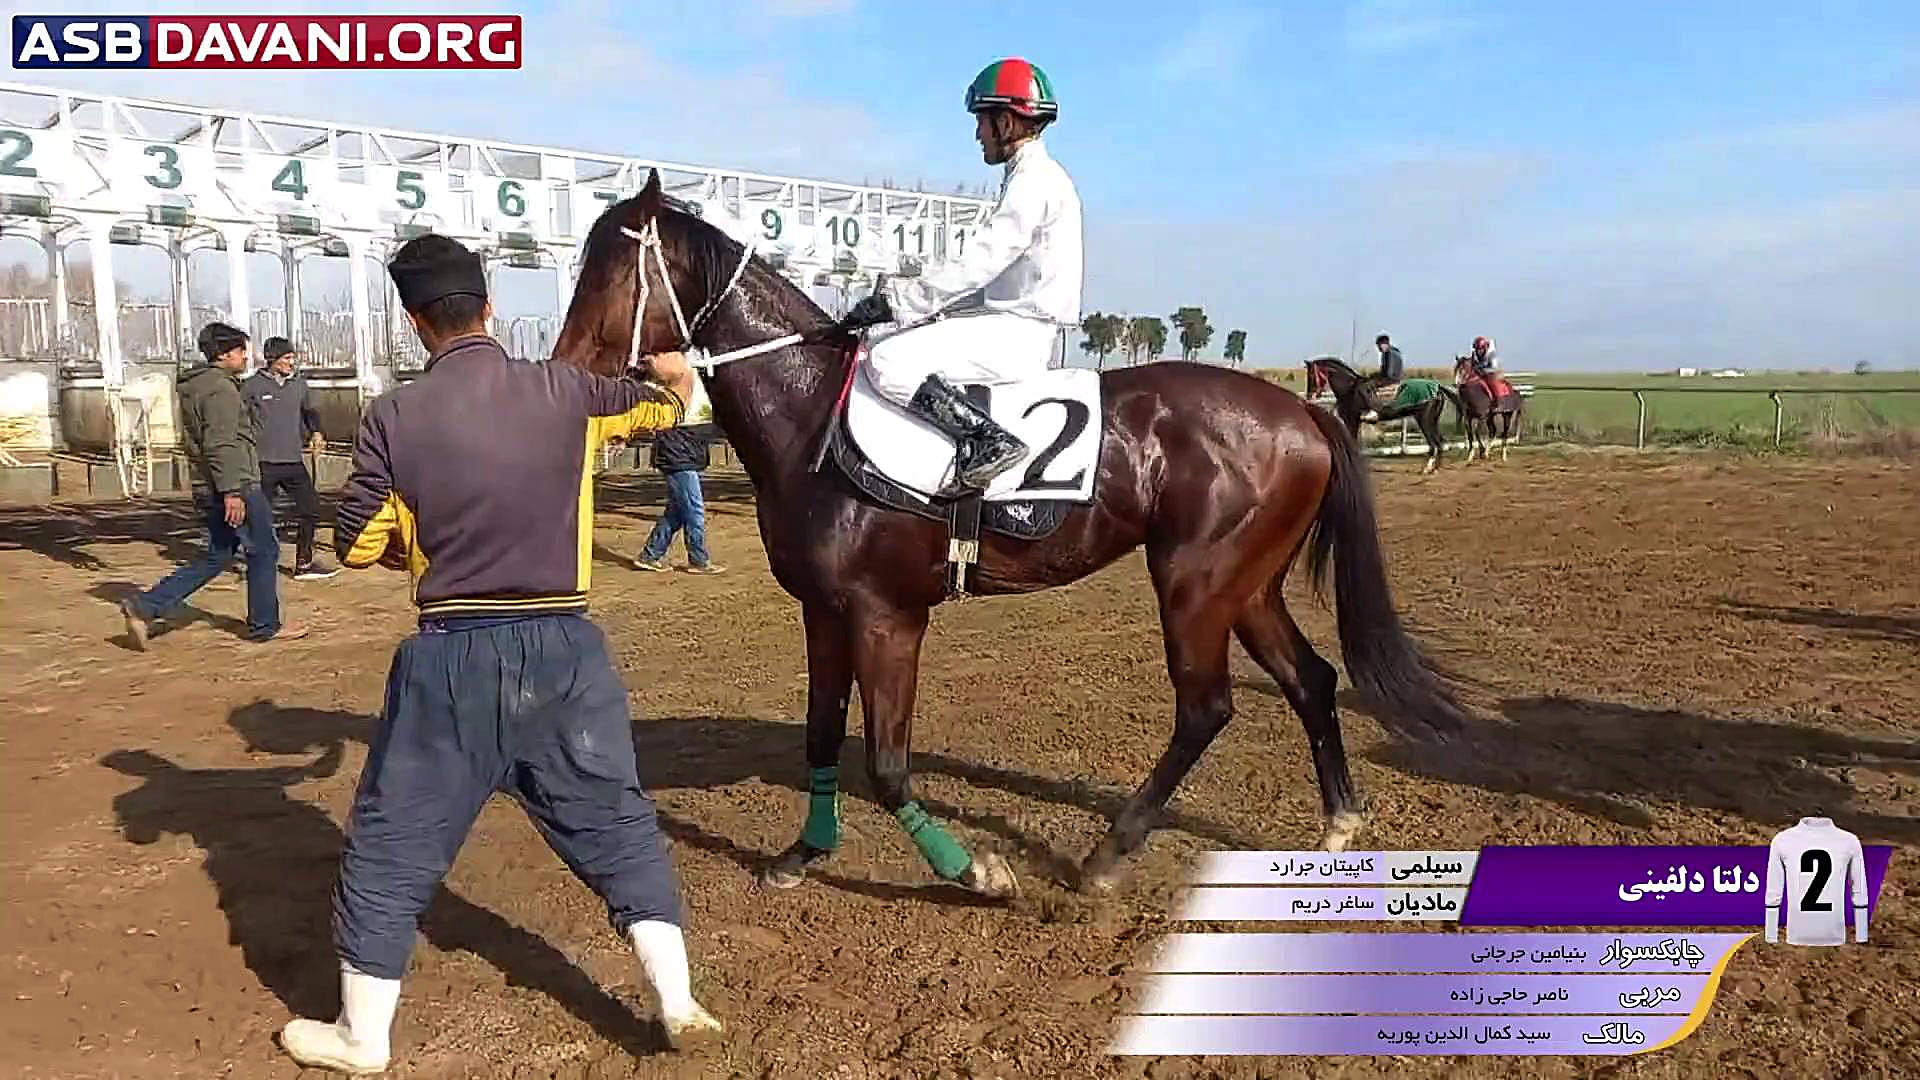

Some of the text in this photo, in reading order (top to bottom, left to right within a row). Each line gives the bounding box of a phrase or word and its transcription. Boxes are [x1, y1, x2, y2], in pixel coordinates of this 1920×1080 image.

[0, 130, 37, 177] 2
[143, 145, 183, 189] 3
[271, 159, 309, 200] 4
[396, 171, 426, 210] 5
[497, 180, 525, 216] 6
[761, 208, 782, 240] 9
[825, 215, 860, 248] 10
[893, 224, 925, 253] 11
[954, 227, 977, 257] 1
[1015, 396, 1091, 492] 2
